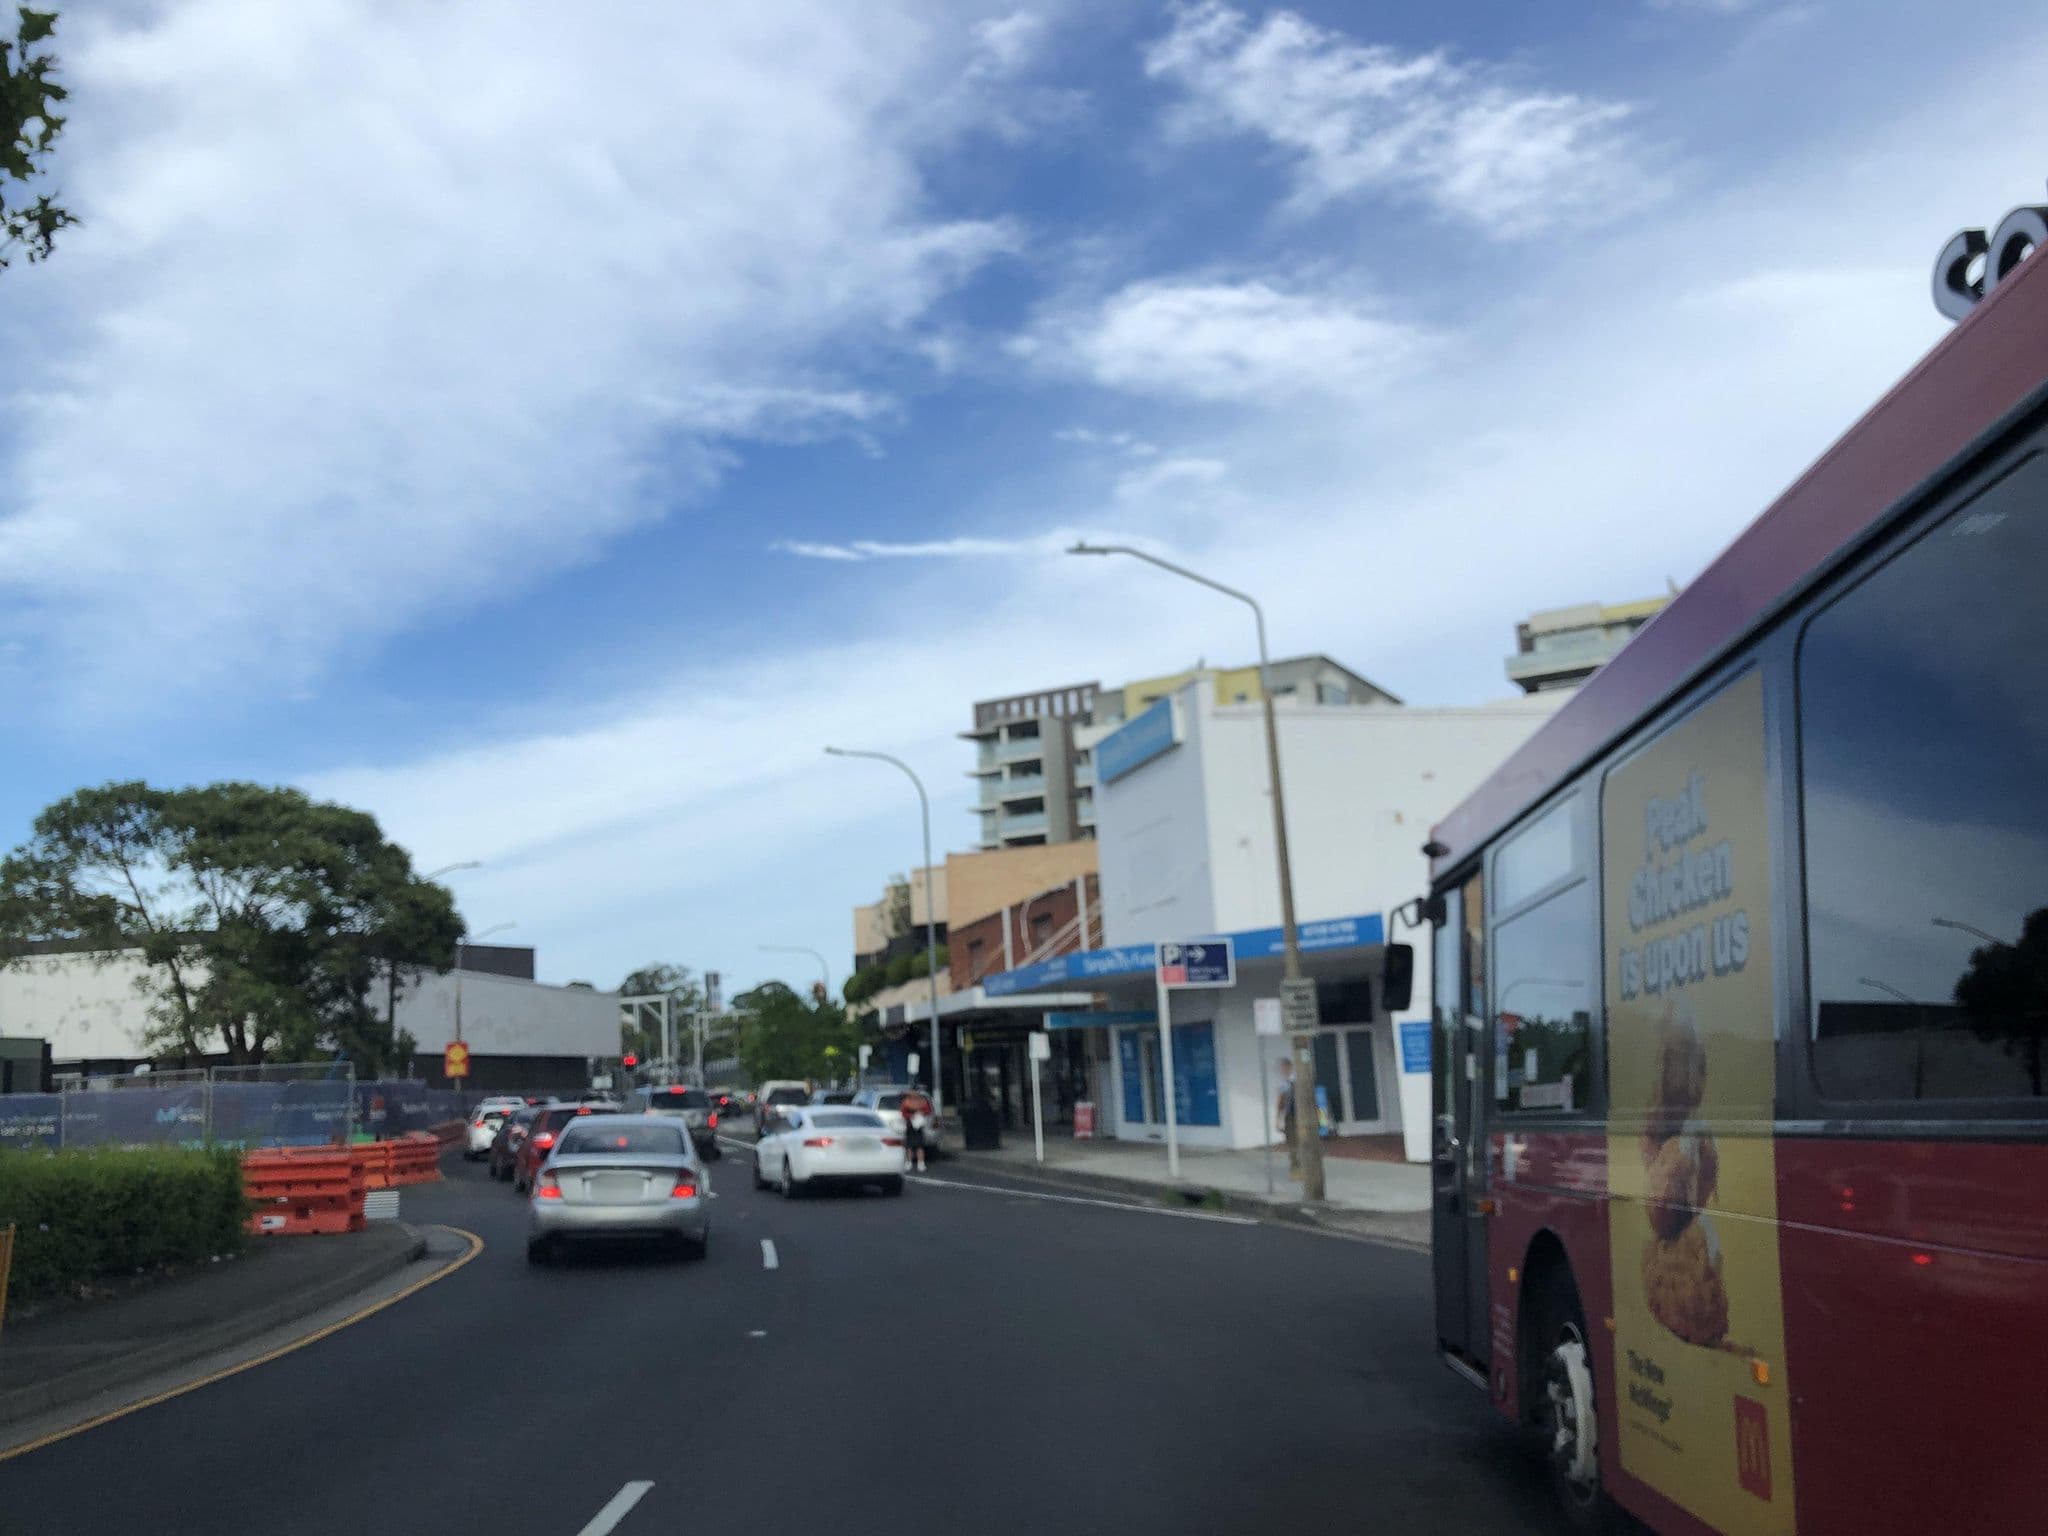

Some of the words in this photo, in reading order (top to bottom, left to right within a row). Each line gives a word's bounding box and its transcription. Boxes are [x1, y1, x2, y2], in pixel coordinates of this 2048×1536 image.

[1645, 766, 1708, 864] Peak
[1620, 946, 1641, 1001] is
[1643, 923, 1707, 996] upon
[1711, 909, 1749, 977] us
